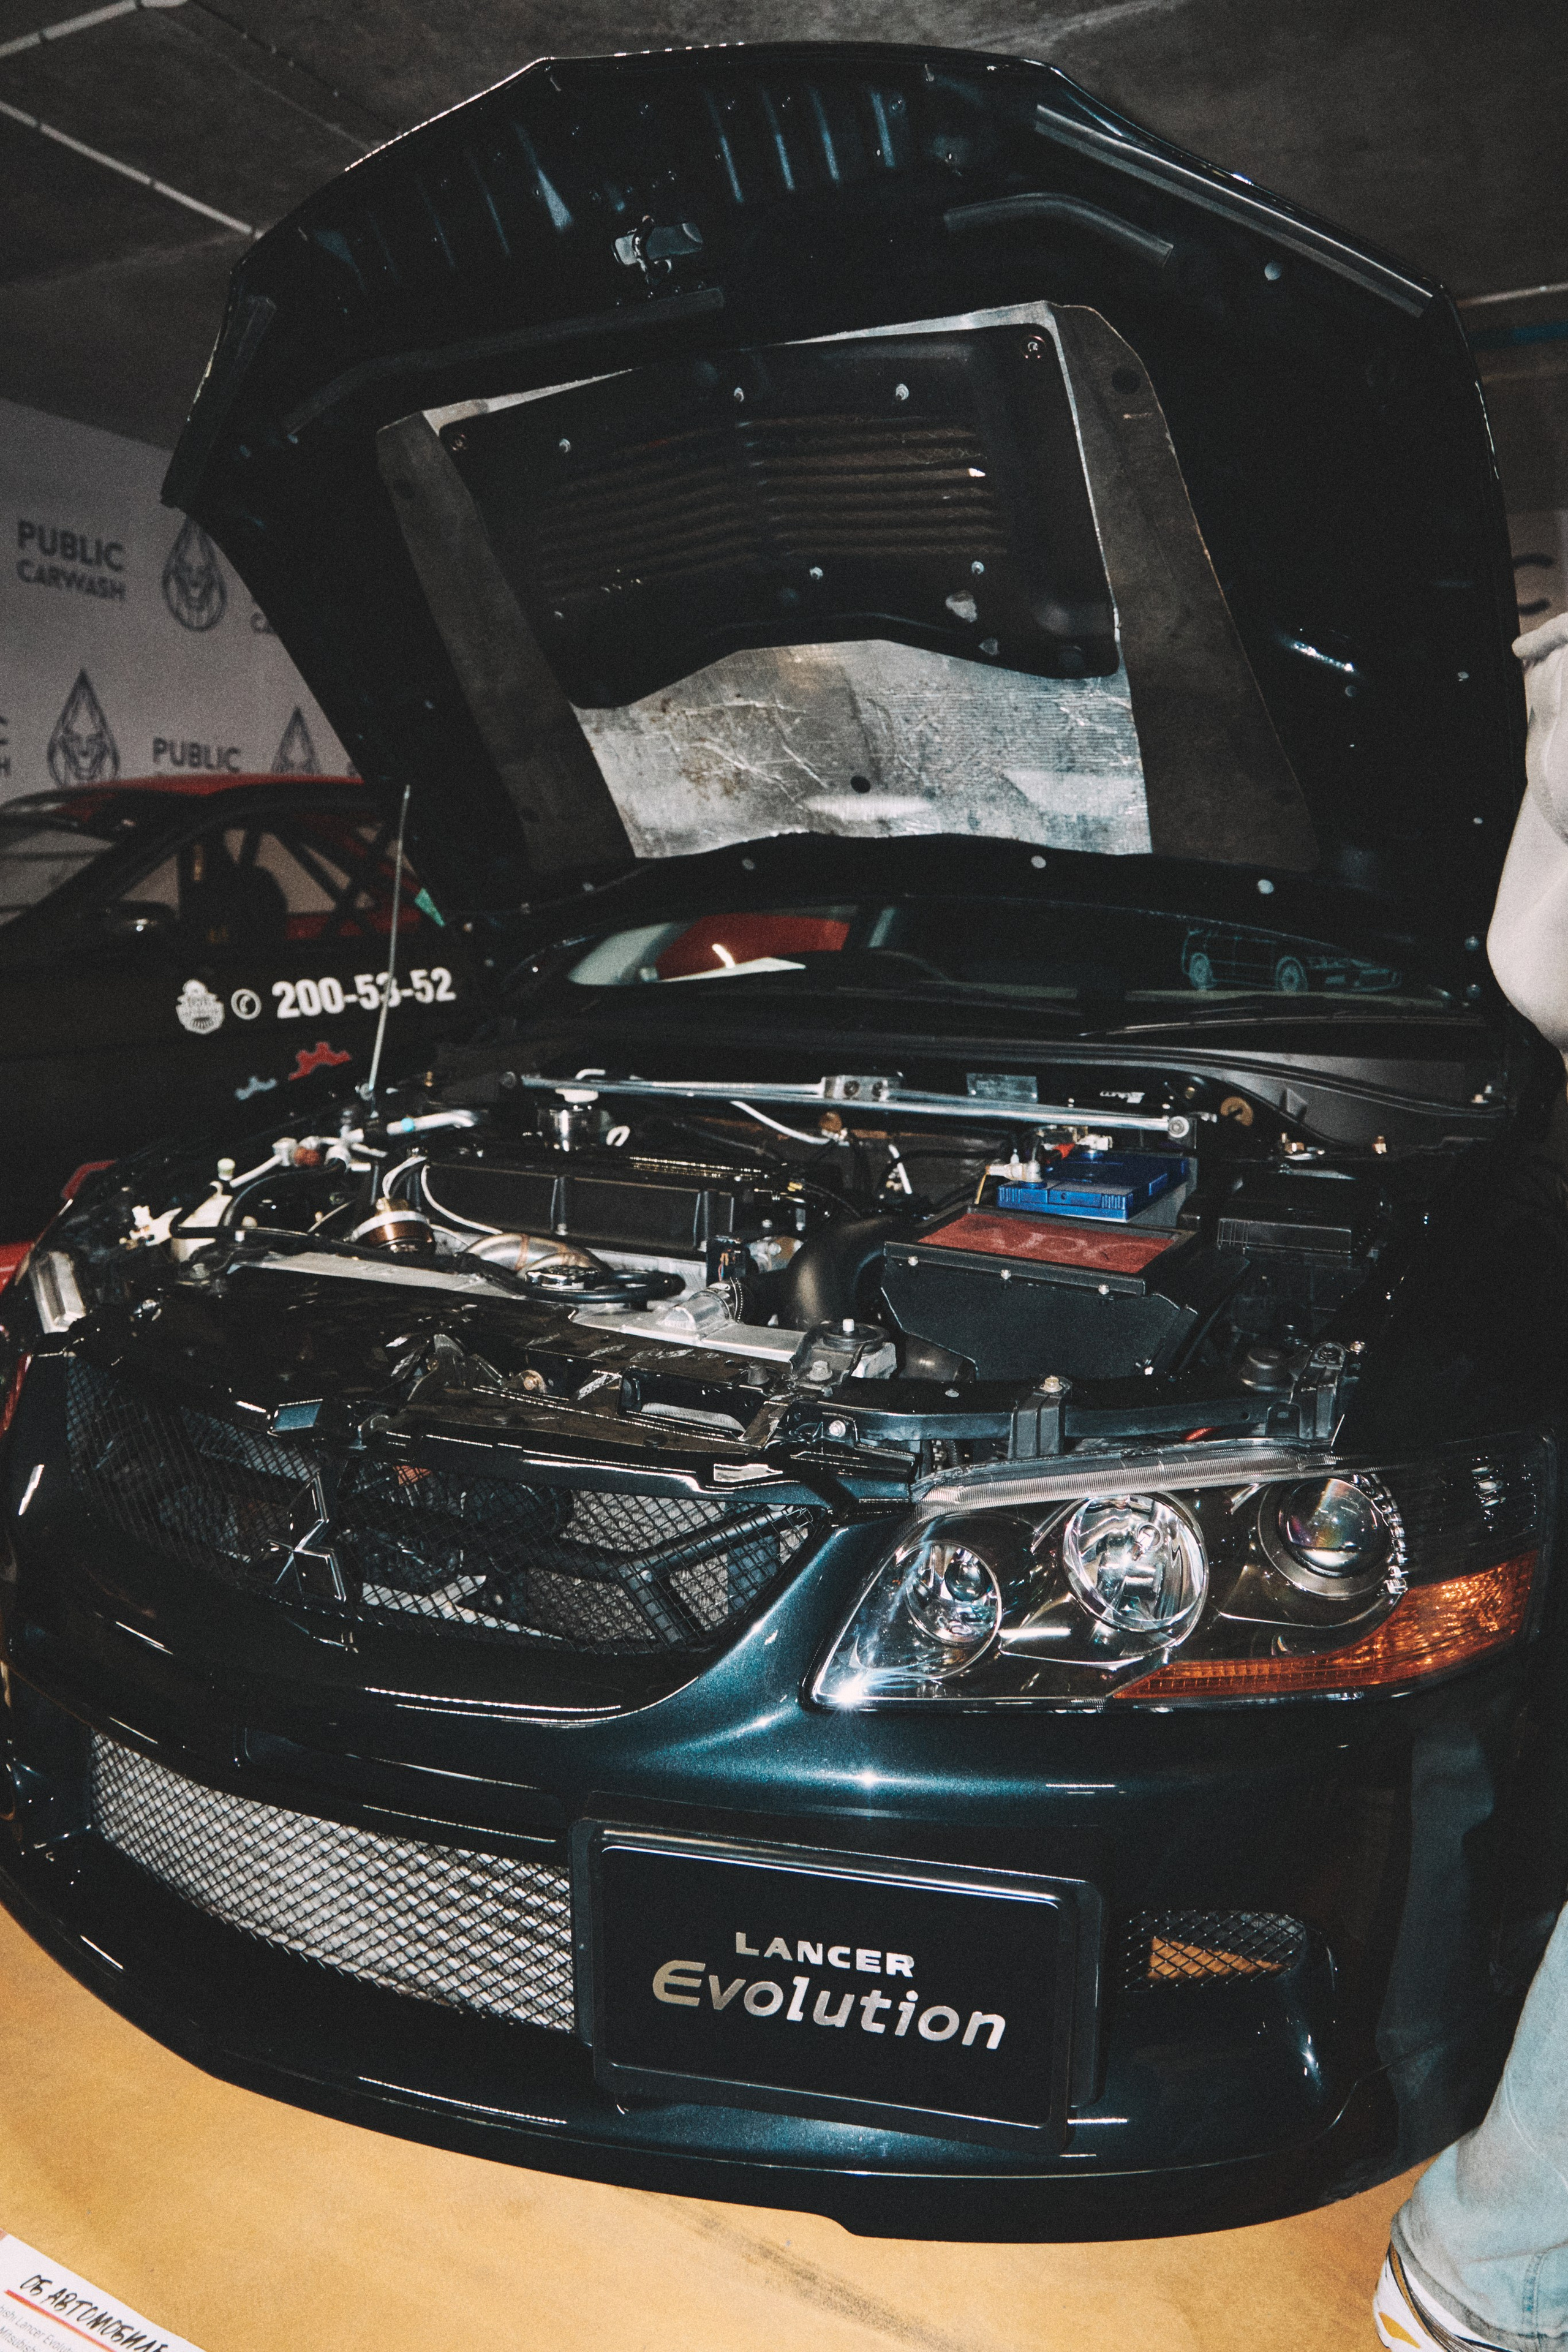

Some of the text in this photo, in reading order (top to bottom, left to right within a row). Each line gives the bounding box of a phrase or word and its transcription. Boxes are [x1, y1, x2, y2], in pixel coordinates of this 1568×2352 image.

[18, 519, 124, 572] PUBLIC
[17, 559, 126, 601] CARWASH
[153, 737, 241, 774] PUBLIC
[271, 967, 456, 1019] 200-53-52
[735, 1931, 915, 1978] LANCER
[652, 1959, 1006, 2050] Evolution
[20, 2274, 53, 2296] ОБ
[15, 2317, 45, 2339] Lancer
